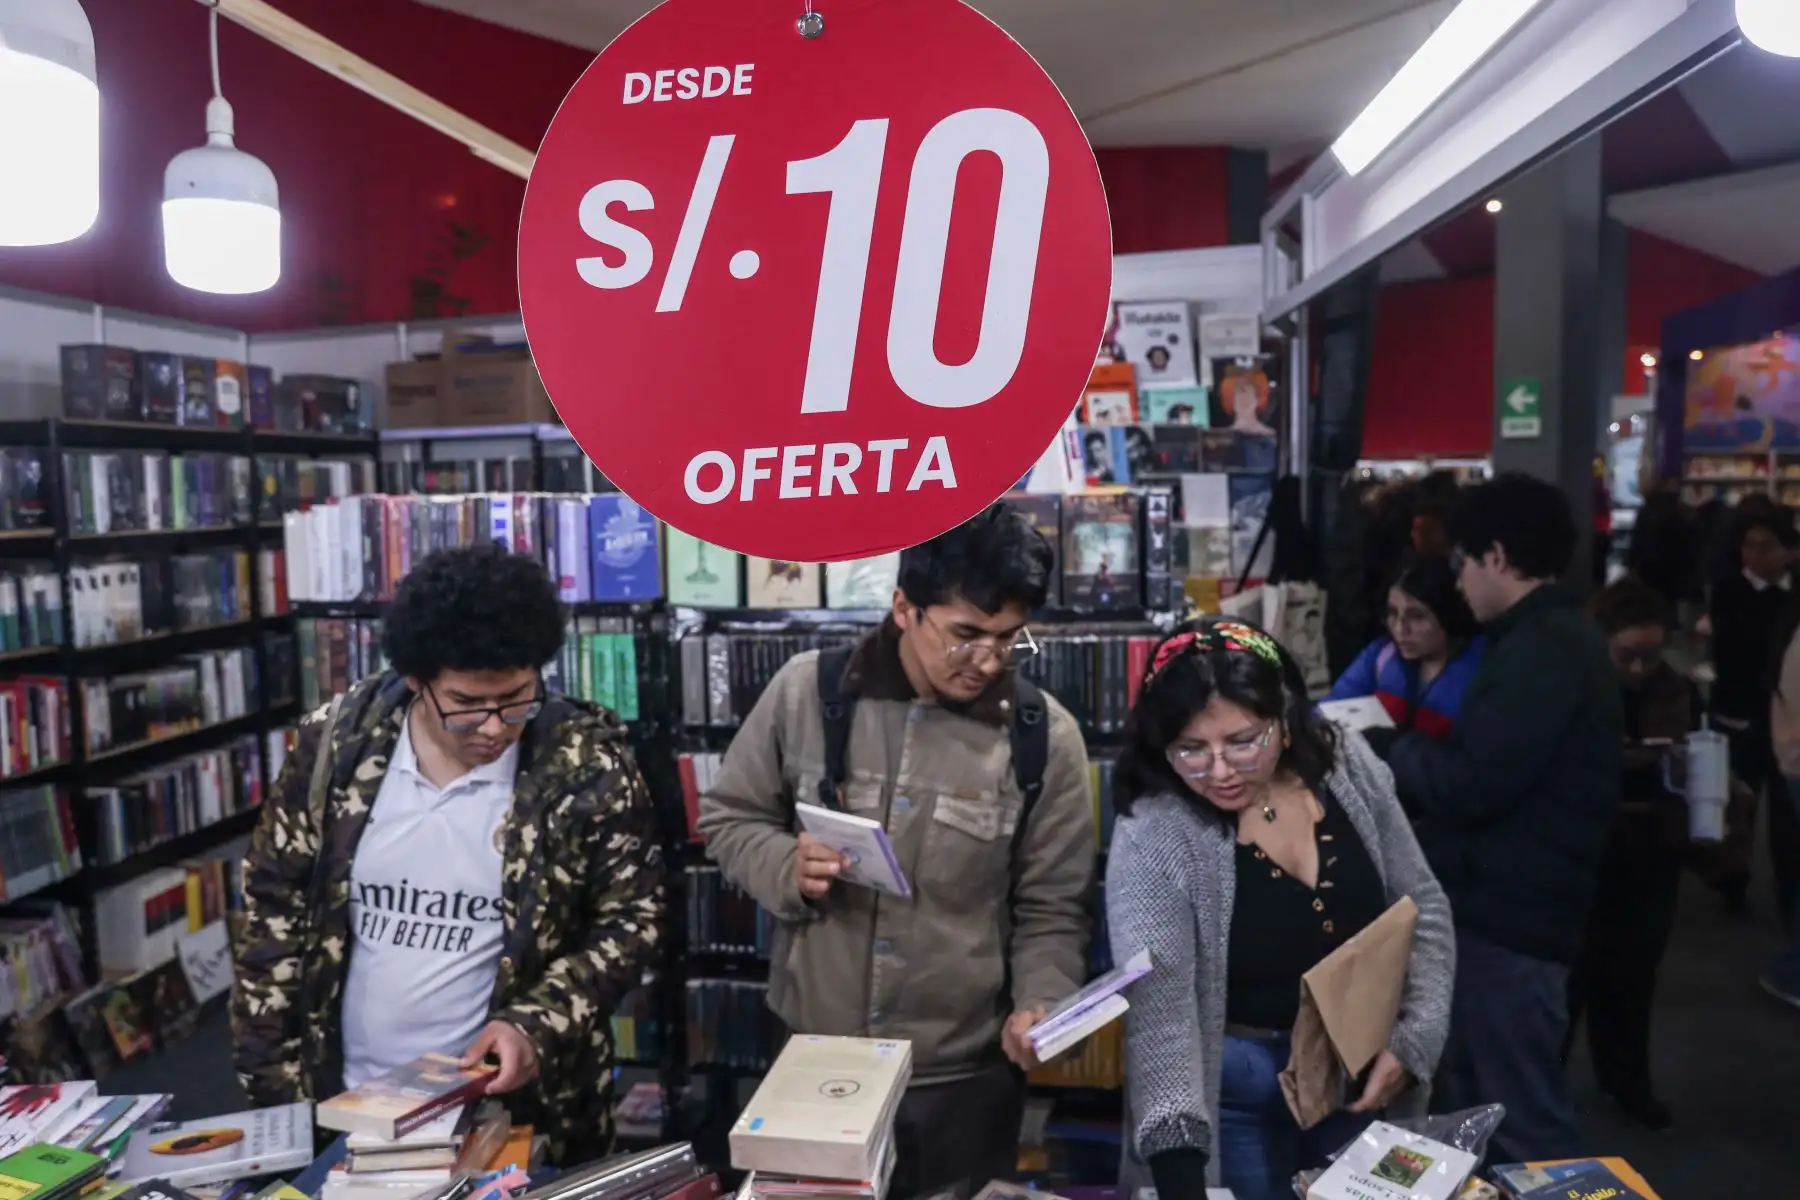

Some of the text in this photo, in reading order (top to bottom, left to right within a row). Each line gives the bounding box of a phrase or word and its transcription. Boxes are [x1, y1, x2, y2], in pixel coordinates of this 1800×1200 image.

[622, 63, 755, 105] DESDE
[683, 436, 958, 505] OFERTA
[350, 878, 504, 922] mirates
[360, 912, 474, 953] FLY BETTER
